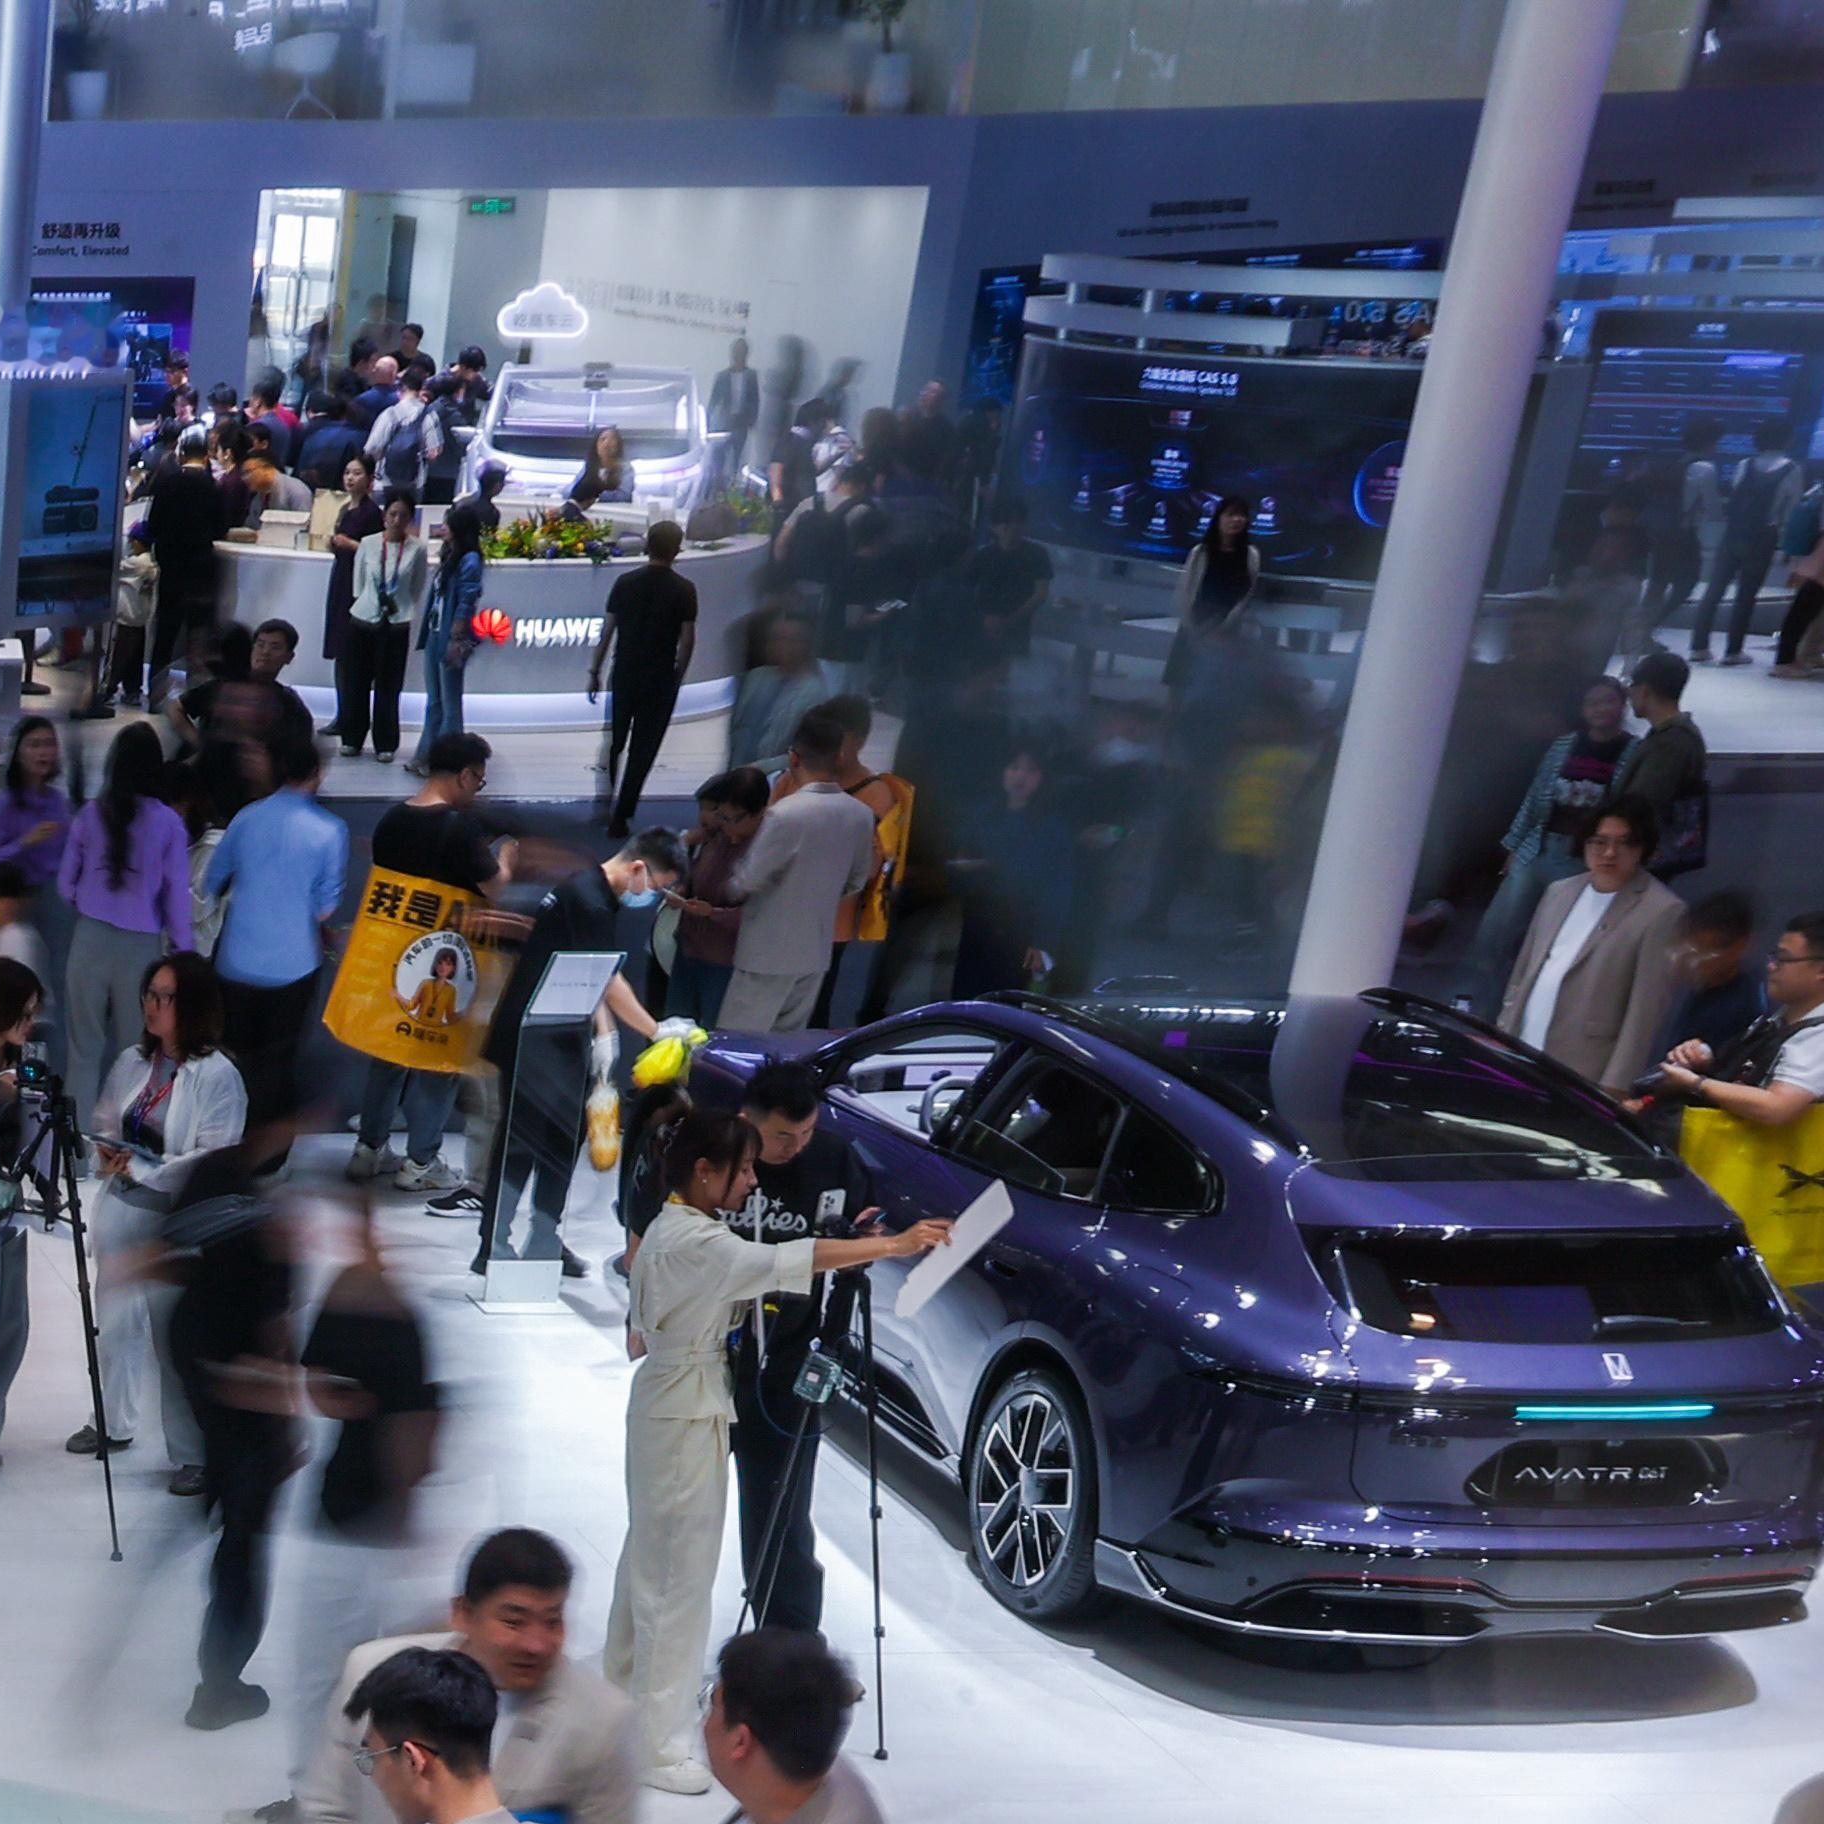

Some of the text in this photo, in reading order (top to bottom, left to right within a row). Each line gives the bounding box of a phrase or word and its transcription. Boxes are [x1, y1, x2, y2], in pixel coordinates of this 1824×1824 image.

[41, 222, 121, 239] 舒适再升级
[82, 245, 129, 256] Elevated
[515, 618, 604, 643] HUAWE
[1514, 1466, 1633, 1481] AVATR
